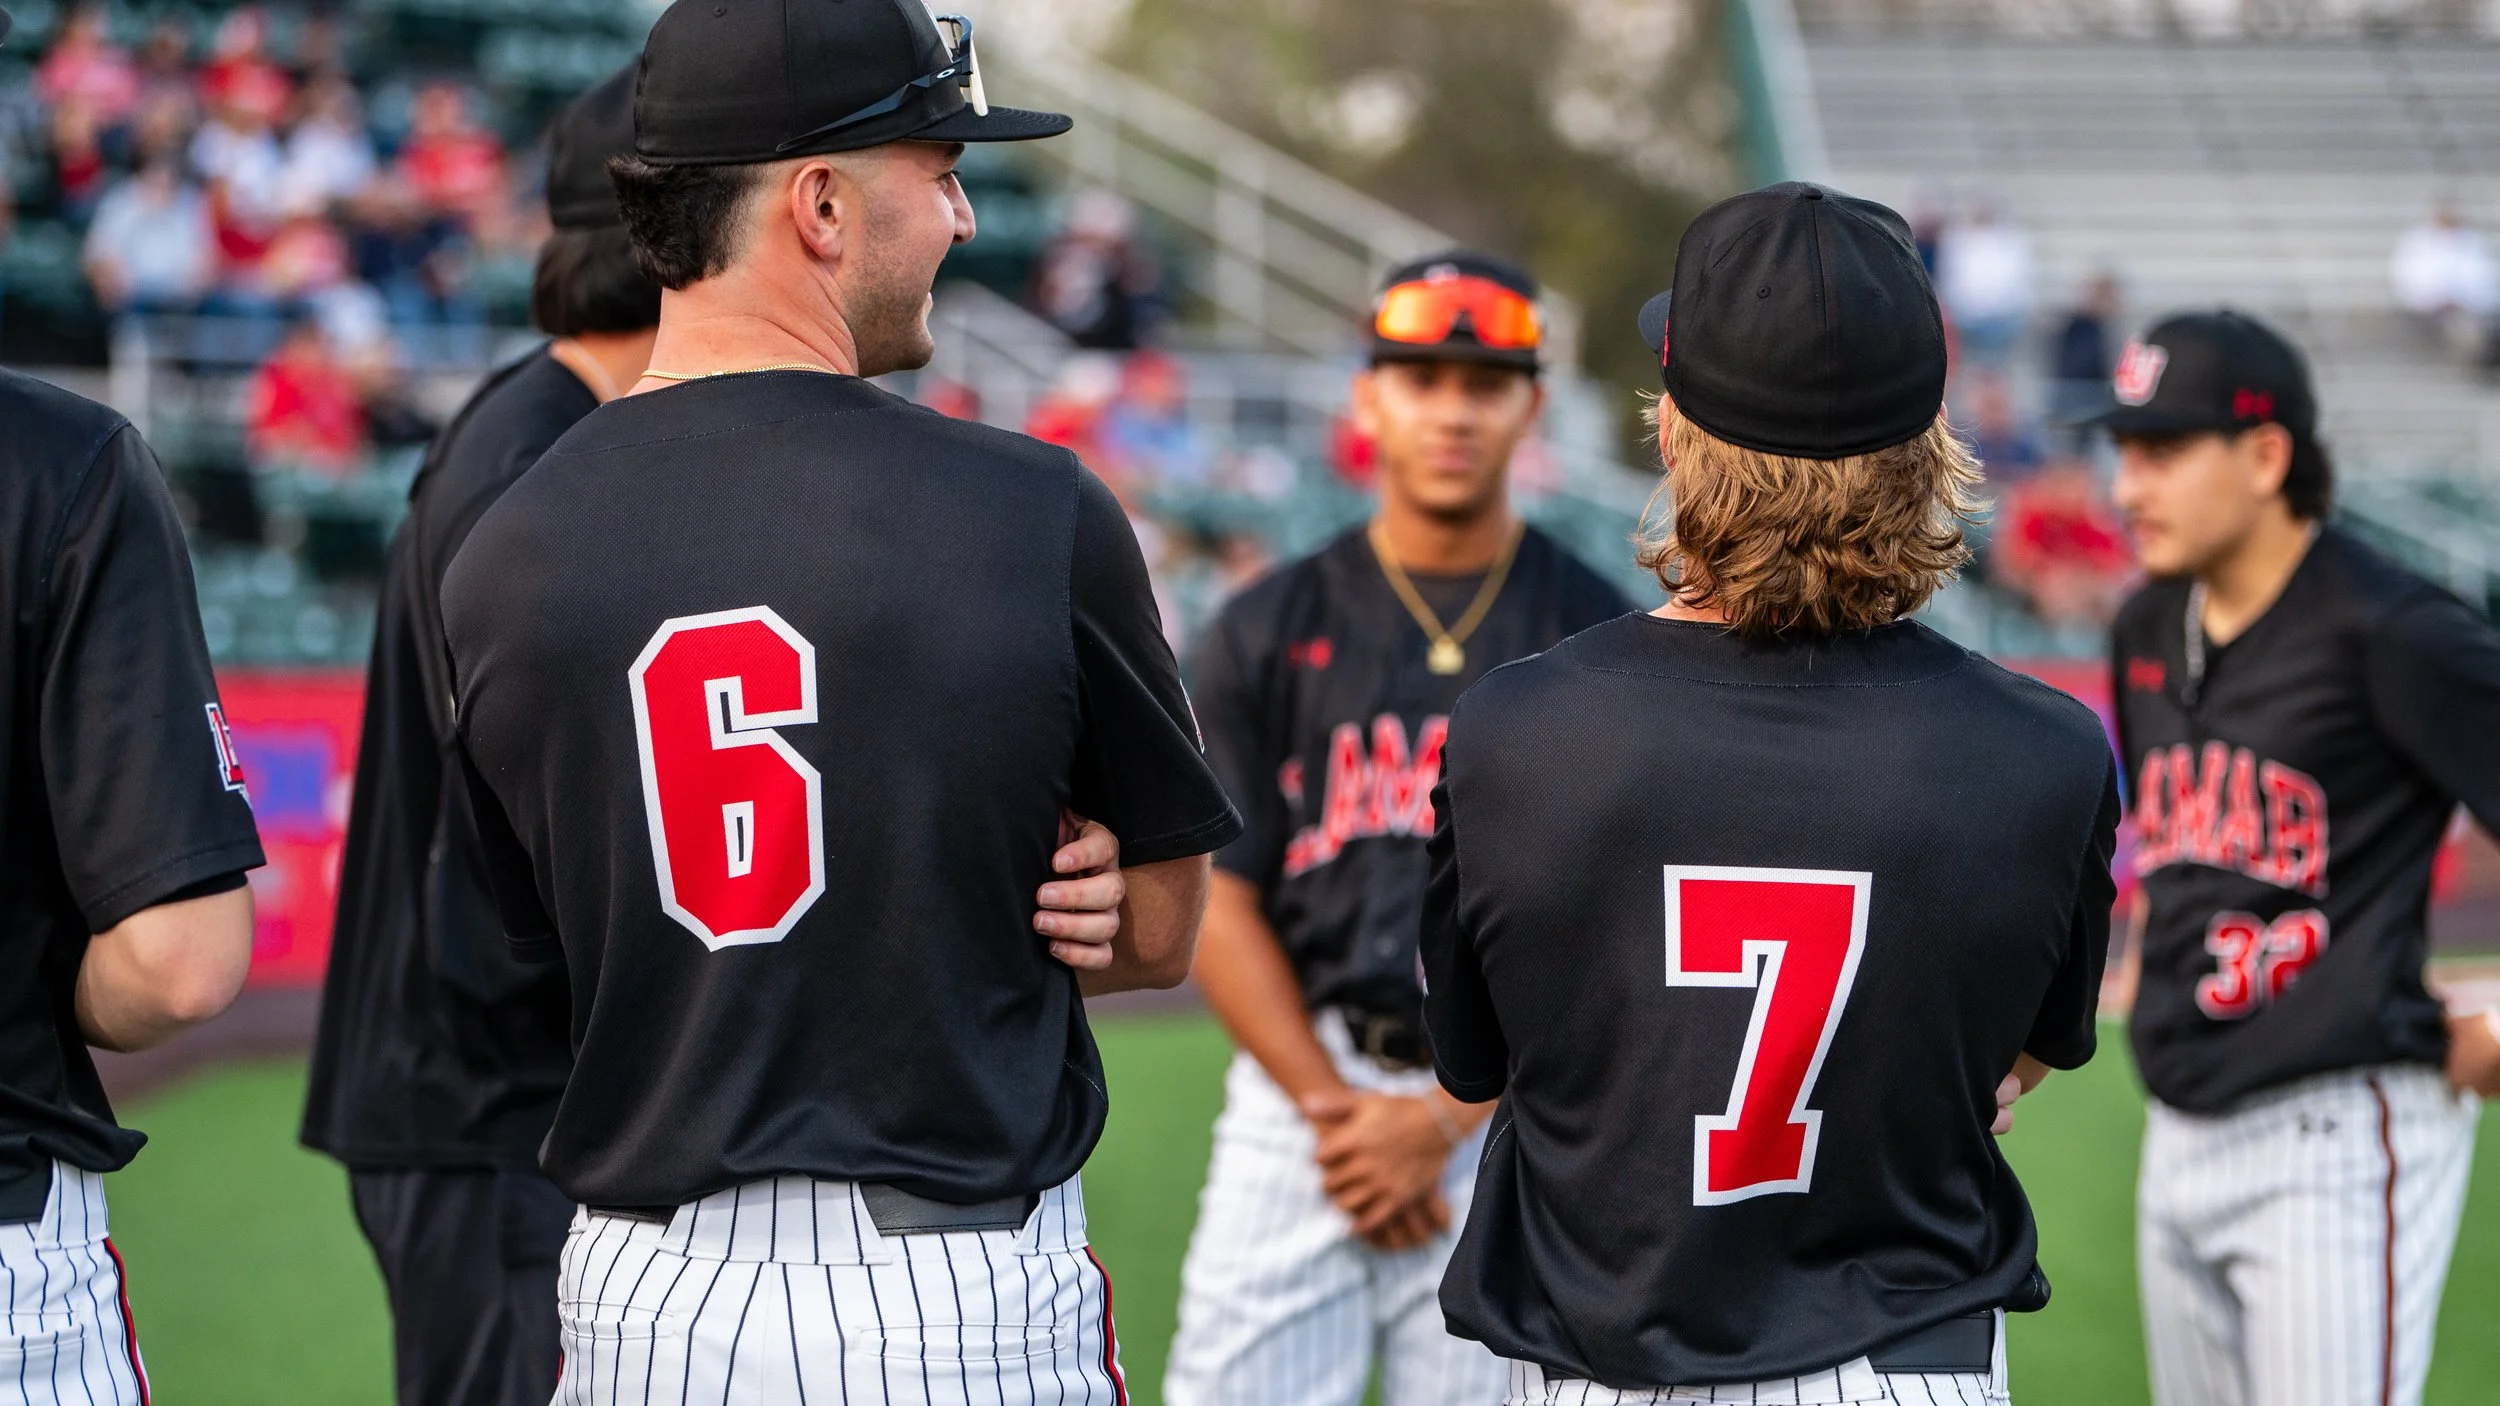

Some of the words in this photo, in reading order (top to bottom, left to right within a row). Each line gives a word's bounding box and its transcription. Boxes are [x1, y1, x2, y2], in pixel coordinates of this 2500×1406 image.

[628, 605, 825, 952] 6
[1663, 864, 1872, 1206] 7
[2195, 908, 2329, 1020] 32
